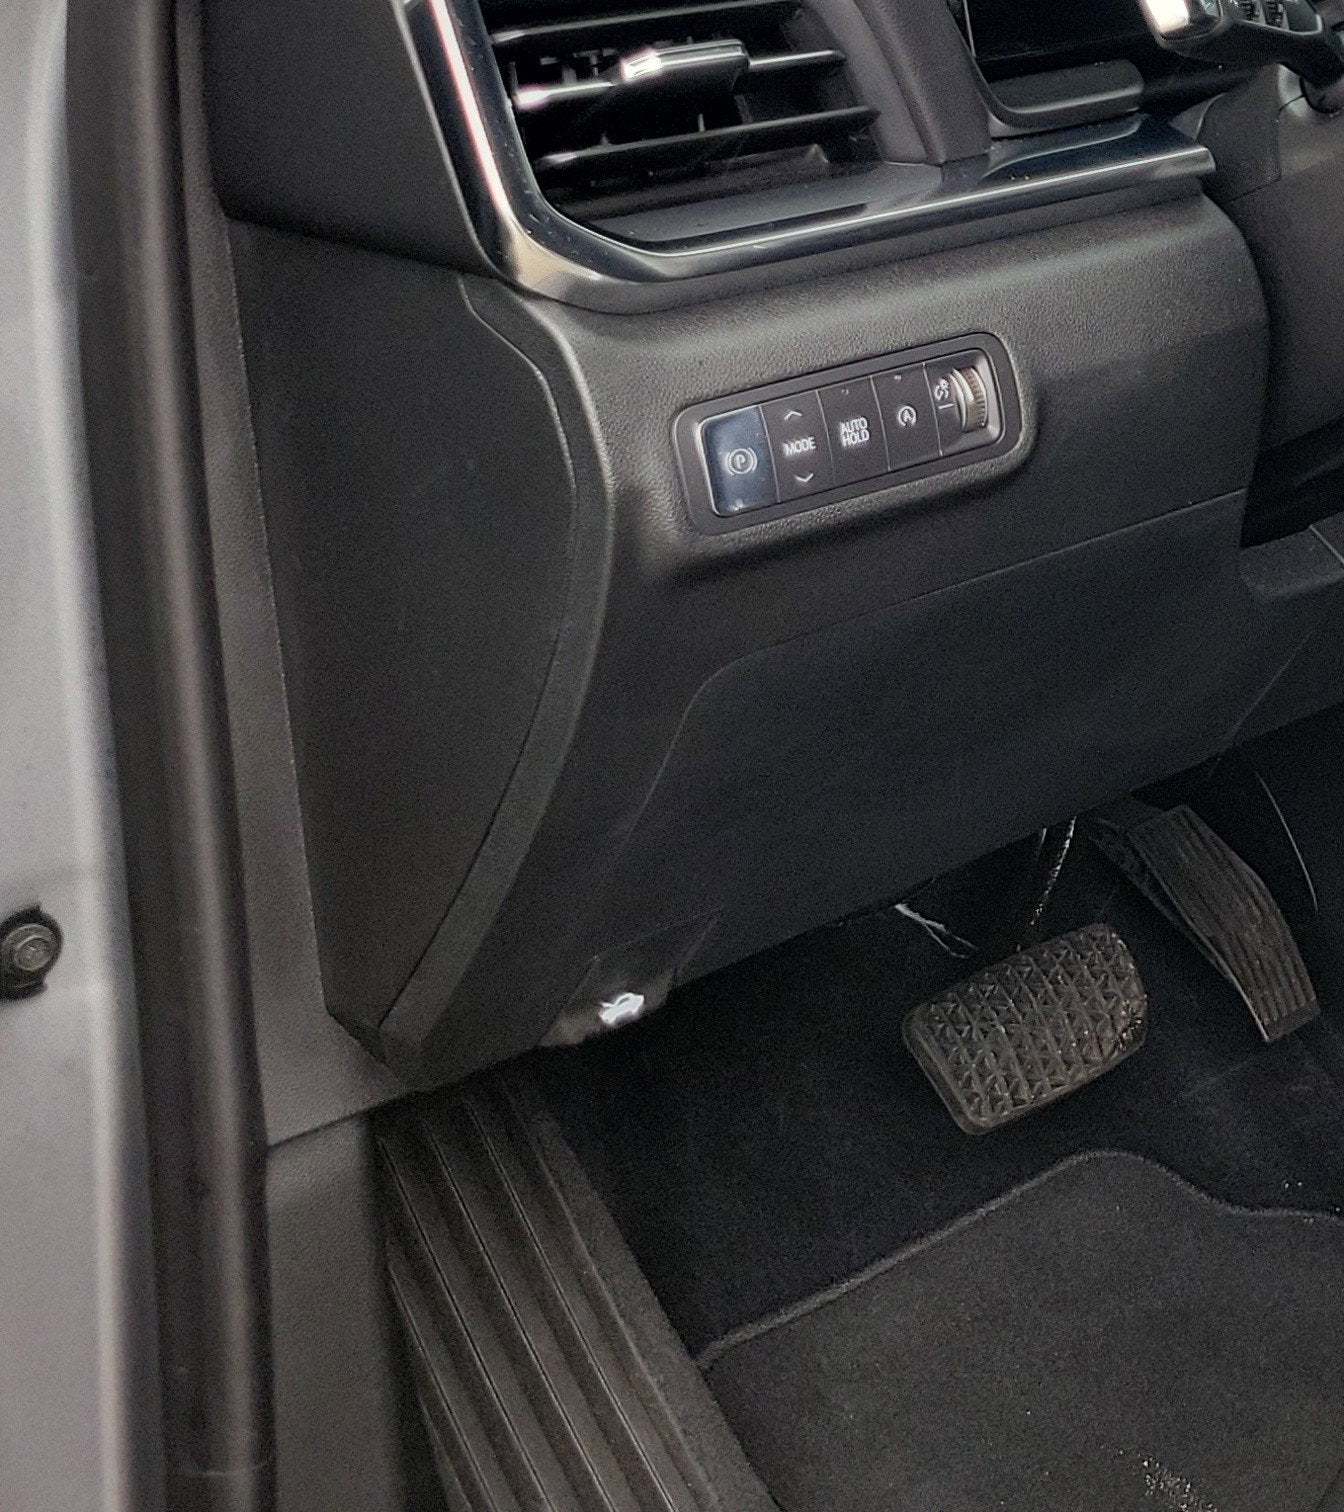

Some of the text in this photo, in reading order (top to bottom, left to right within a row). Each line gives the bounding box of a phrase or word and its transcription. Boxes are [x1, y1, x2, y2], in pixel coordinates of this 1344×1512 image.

[840, 417, 868, 435] AUTO
[783, 437, 816, 456] MODE
[842, 429, 870, 447] HOLD
